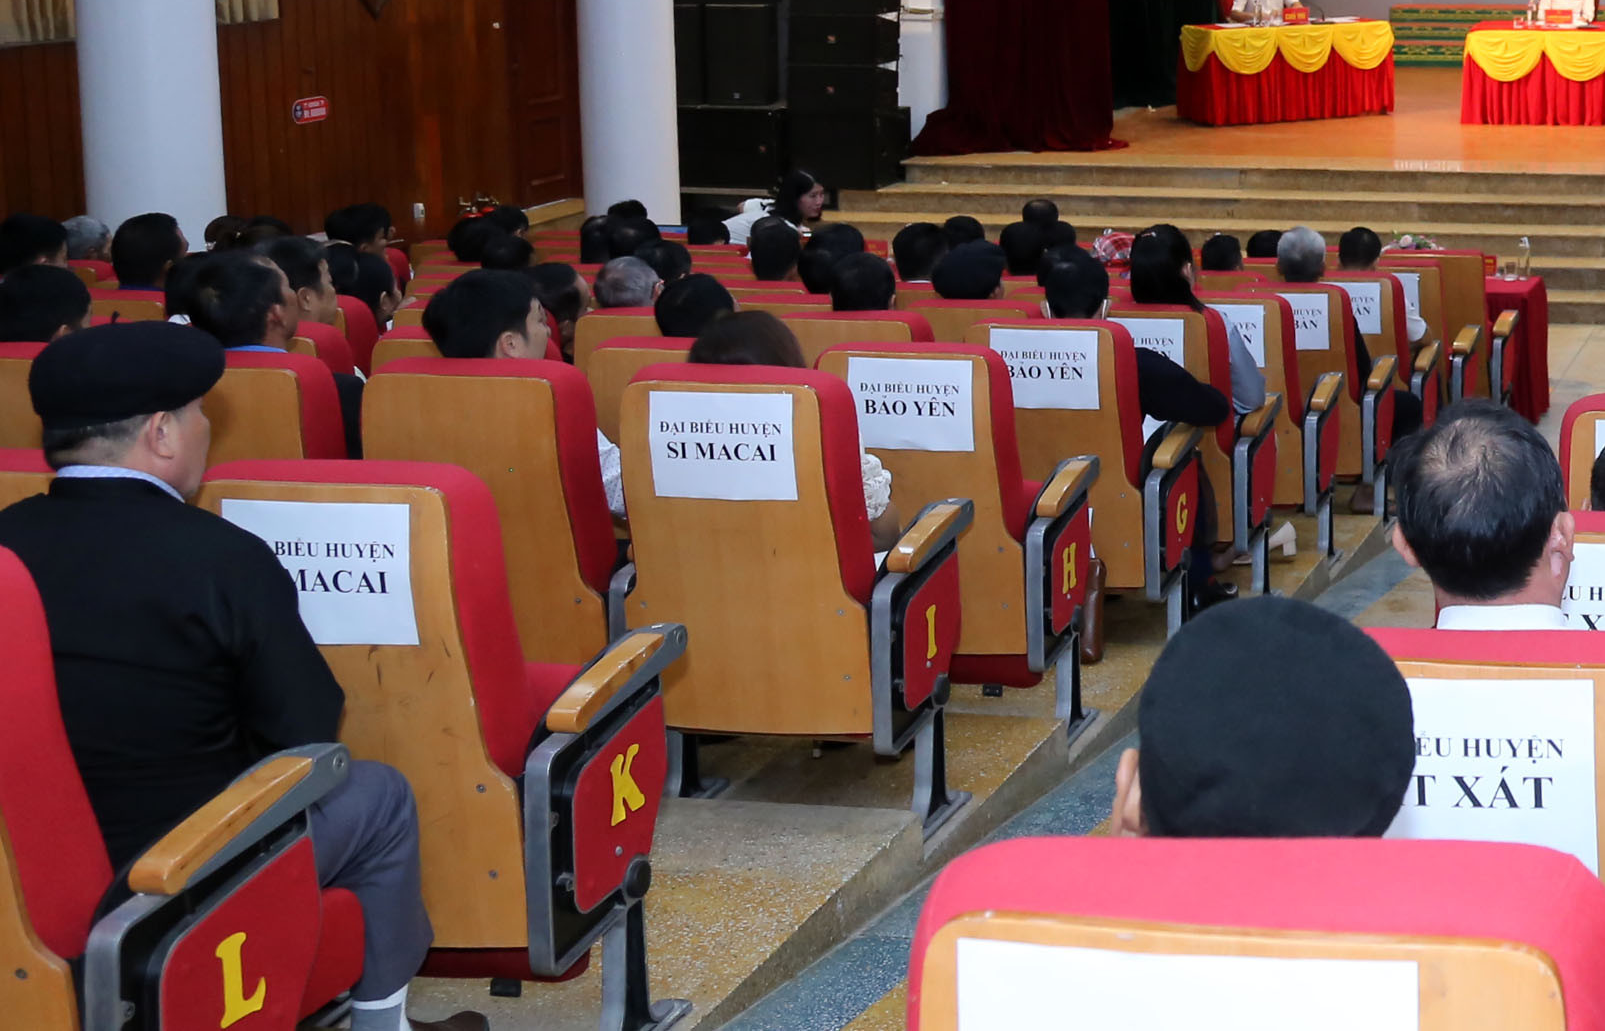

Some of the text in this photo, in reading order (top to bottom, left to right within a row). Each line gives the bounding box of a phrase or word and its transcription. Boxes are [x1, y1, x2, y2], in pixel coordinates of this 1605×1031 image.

[1049, 350, 1087, 364] HUYỆN
[1048, 362, 1084, 381] YÊN
[860, 379, 960, 397] ĐẠI BIỂU HUYỆN
[864, 394, 956, 417] BẢO YÊN
[660, 418, 783, 439] ĐẠI BIỂU HUYỆN
[667, 440, 777, 463] SI MACAI
[1175, 491, 1189, 535] G
[274, 537, 396, 563] BIỂU HUYỆN
[1062, 541, 1077, 595] H
[925, 603, 938, 660] I
[1462, 734, 1565, 765] HUYỆN
[609, 742, 648, 828] K
[1451, 765, 1554, 810] XÁT
[214, 930, 268, 1029] L
